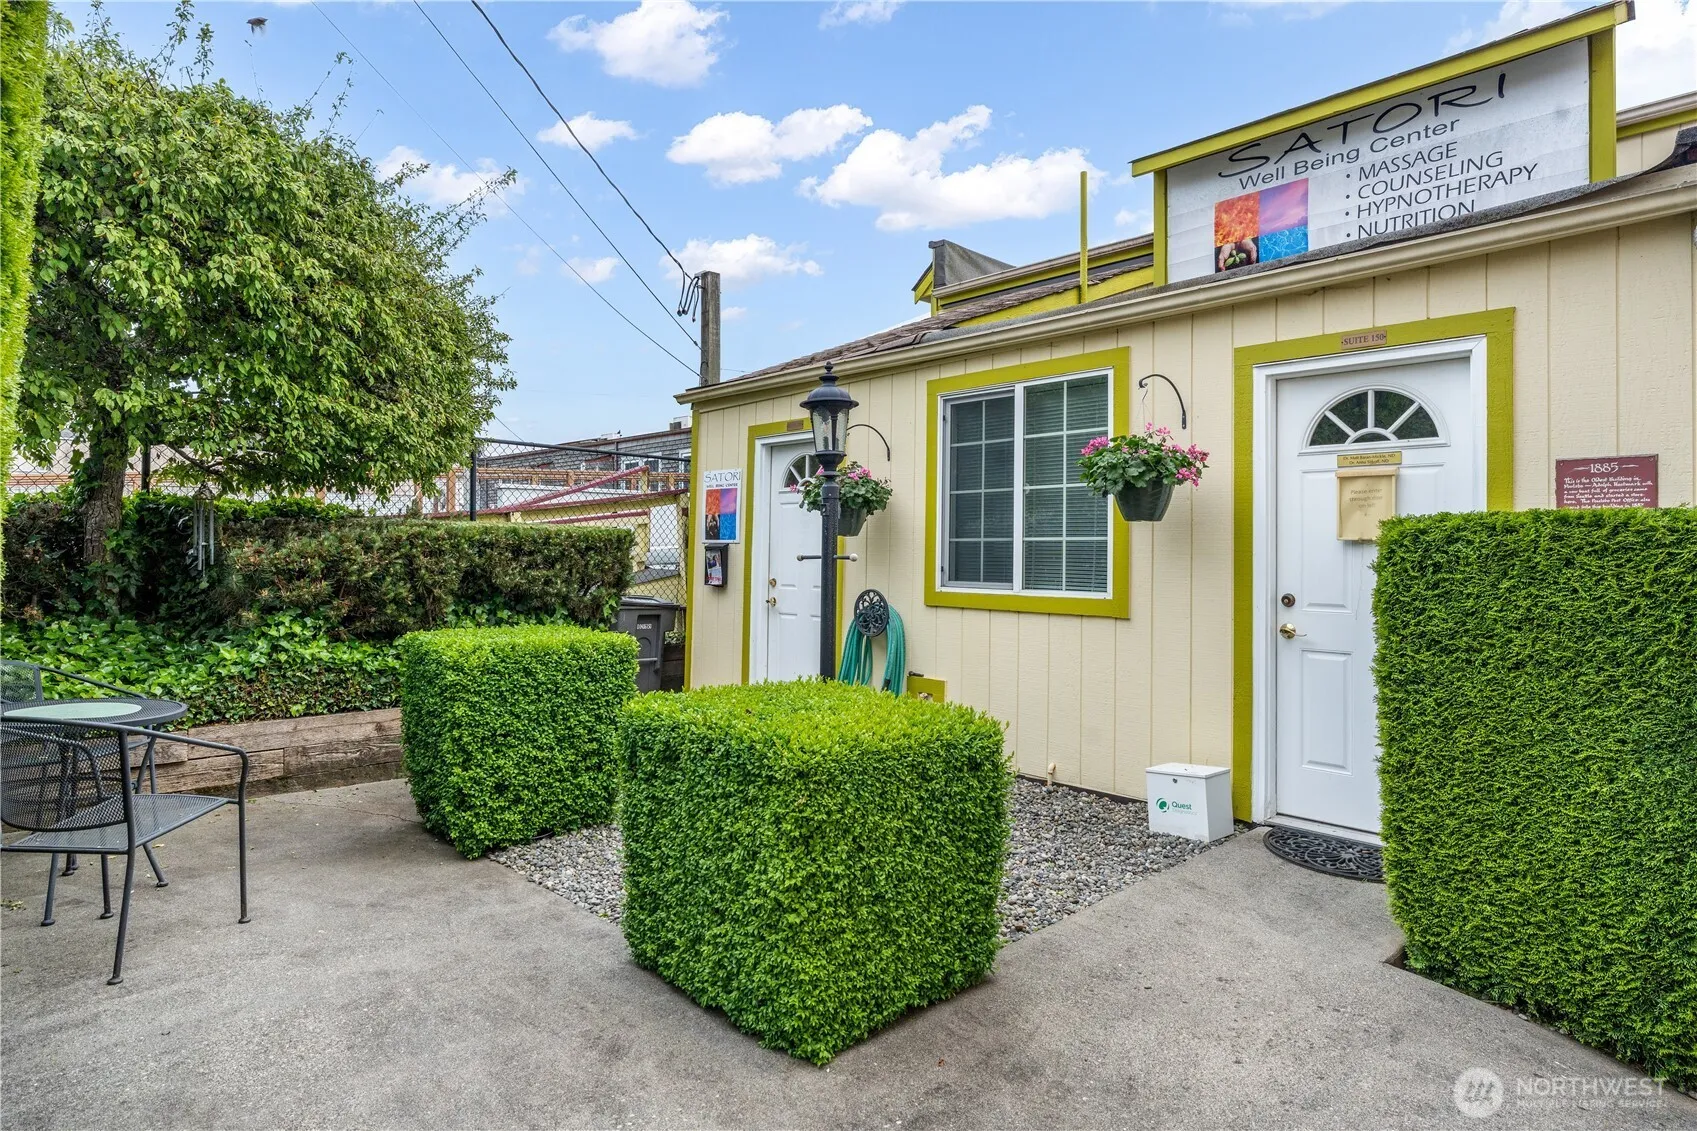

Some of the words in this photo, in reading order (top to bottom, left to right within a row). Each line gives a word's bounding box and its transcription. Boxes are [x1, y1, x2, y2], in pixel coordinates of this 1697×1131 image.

[1218, 72, 1506, 177] SATORI
[1238, 166, 1285, 190] Well
[1294, 147, 1360, 176] Being
[1370, 119, 1460, 153] Center
[1358, 142, 1458, 181] MASSAGE
[1357, 163, 1538, 218] HYPNOTHERAPY
[1358, 151, 1503, 199] COUNSELING
[1358, 199, 1475, 239] NUTRITION
[1343, 335, 1369, 345] SUITE
[1371, 333, 1384, 342] 150
[704, 471, 741, 483] SATORI
[1590, 462, 1619, 473] 1885
[1172, 801, 1192, 810] Quest
